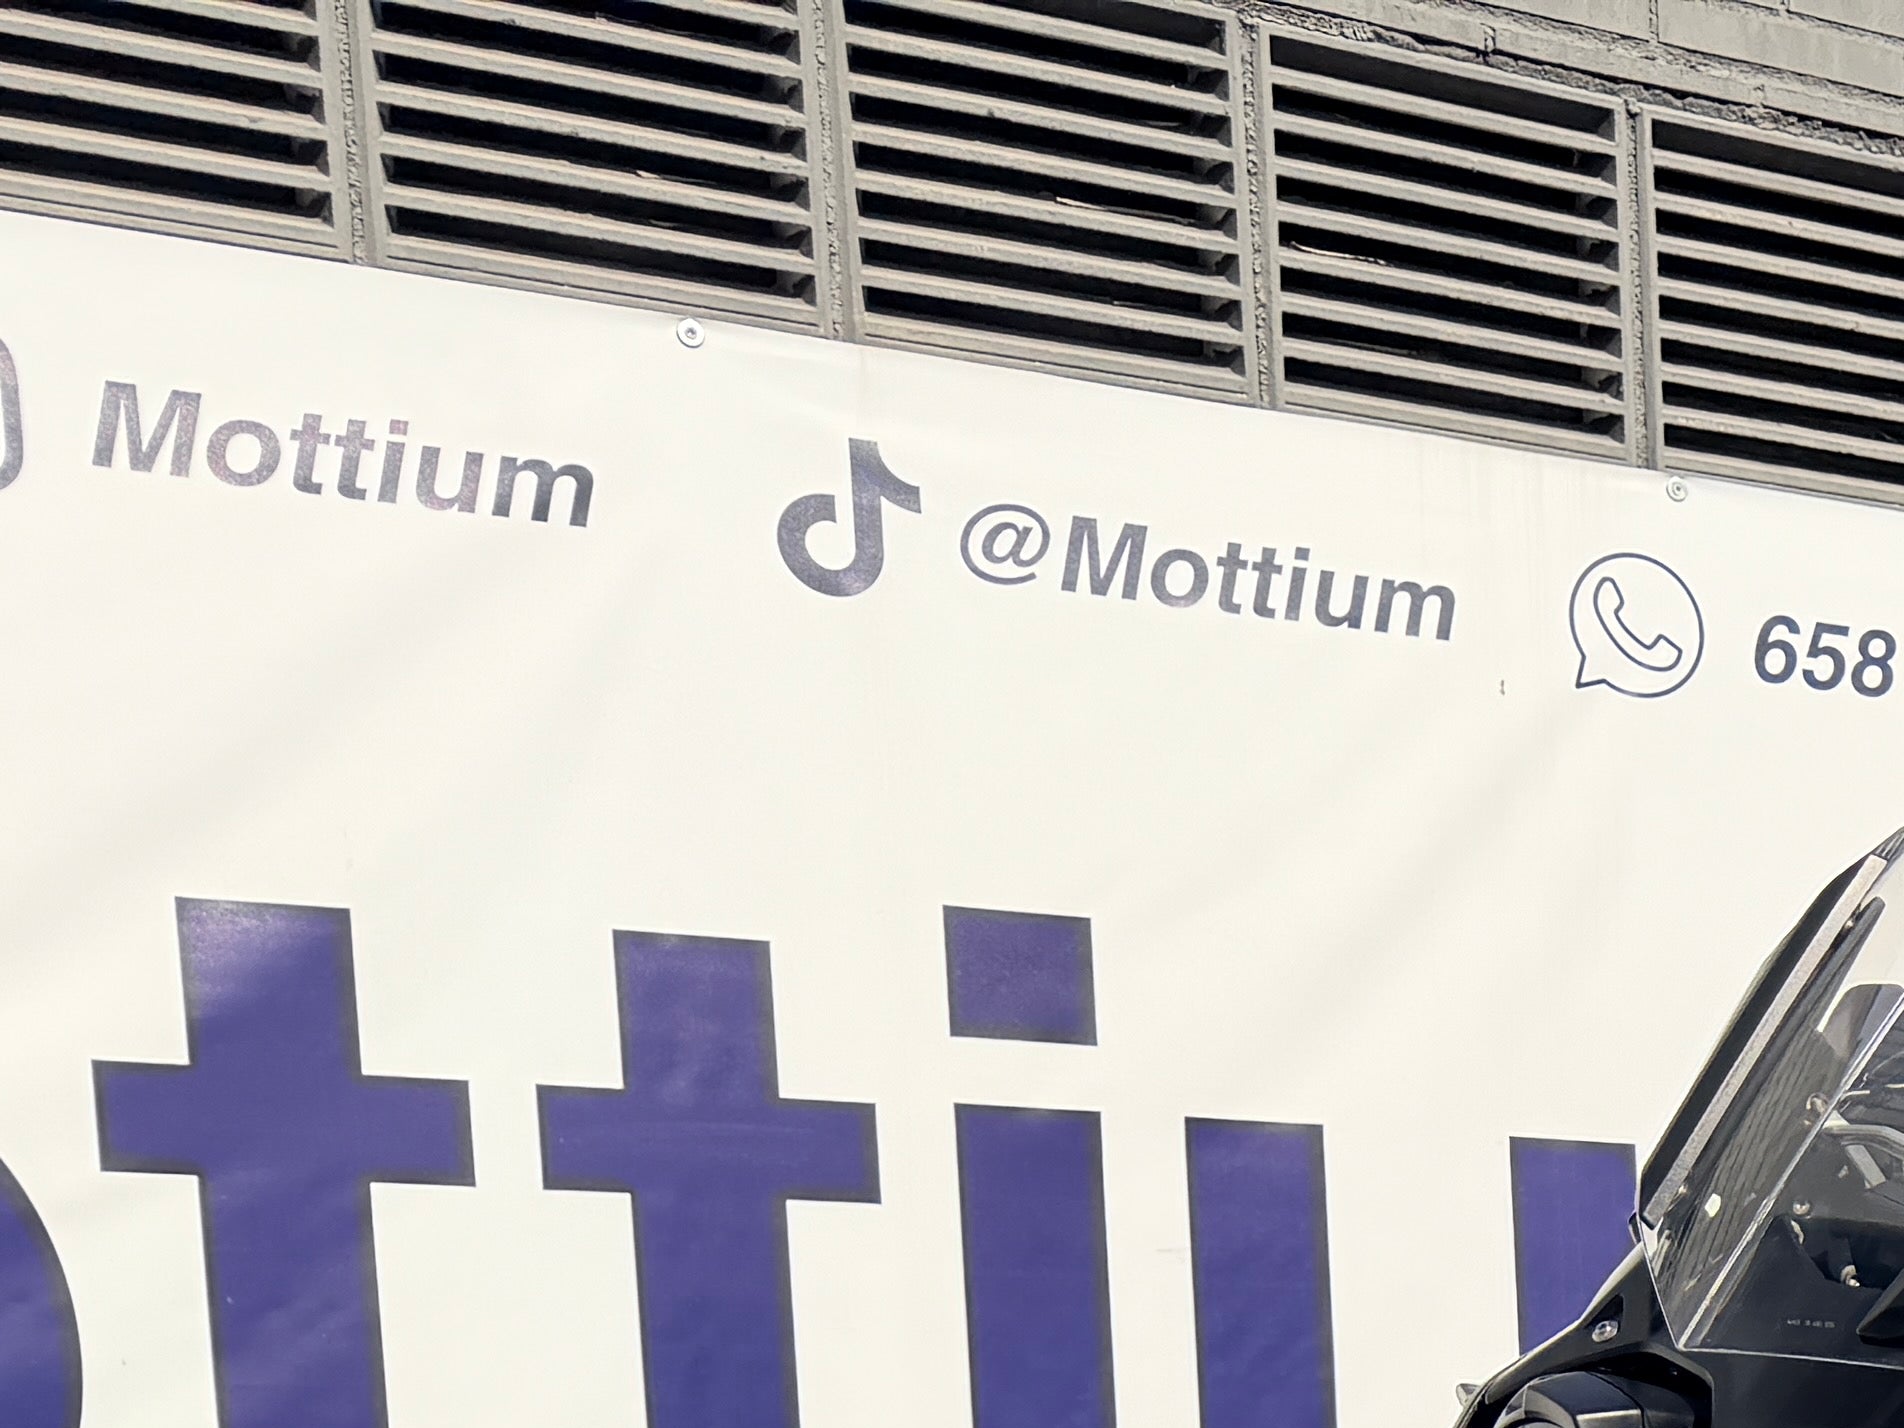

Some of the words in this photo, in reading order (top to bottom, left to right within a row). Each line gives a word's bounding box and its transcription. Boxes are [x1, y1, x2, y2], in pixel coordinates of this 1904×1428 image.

[92, 379, 595, 528] Mottium
[960, 503, 1456, 641] @Mottium
[1754, 615, 1897, 698] 658
